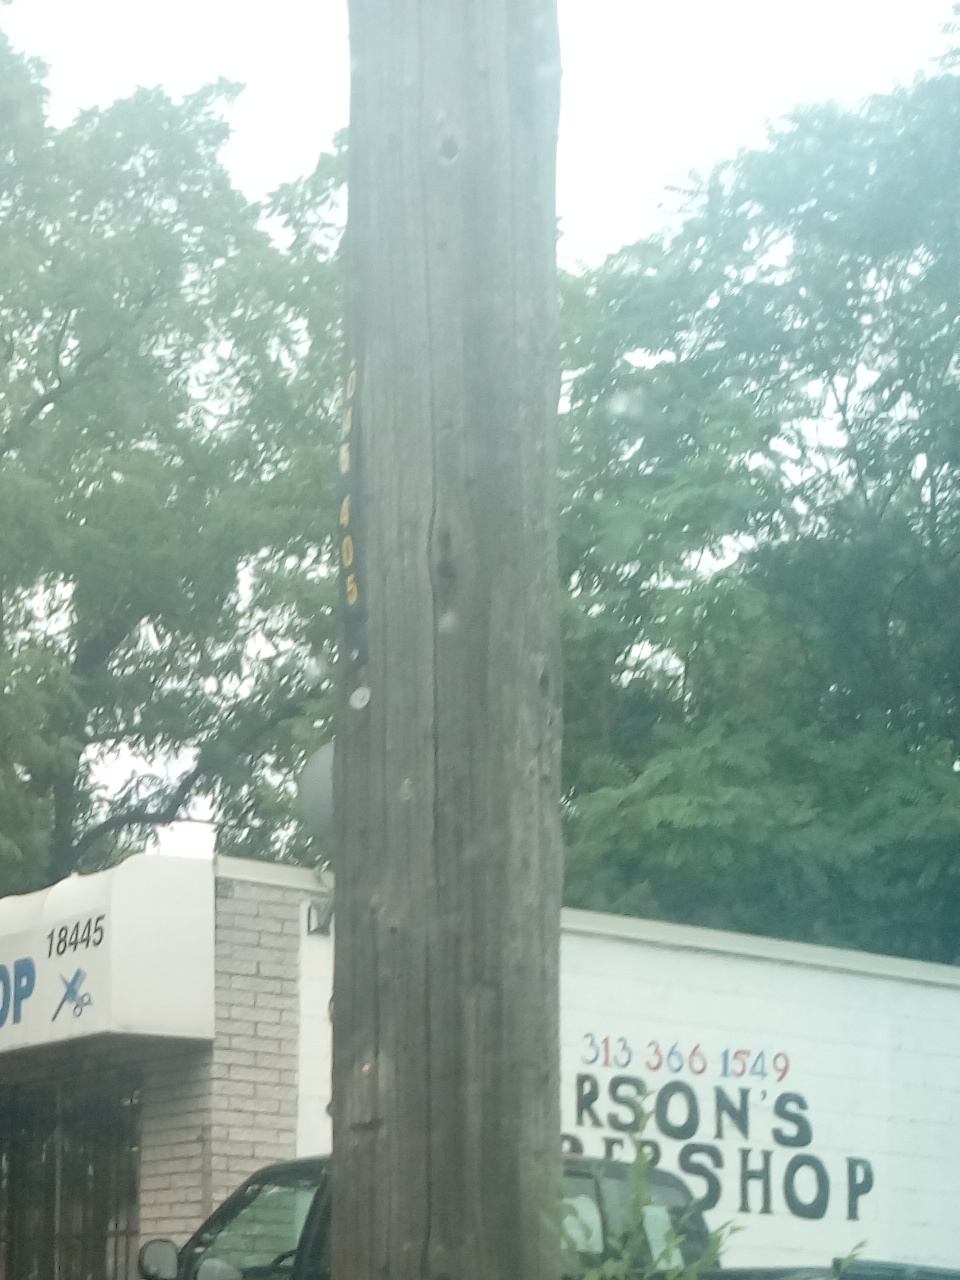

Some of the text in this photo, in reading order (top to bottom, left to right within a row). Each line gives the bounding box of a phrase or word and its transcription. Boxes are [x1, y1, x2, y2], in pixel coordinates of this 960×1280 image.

[45, 914, 107, 959] 18445
[581, 1032, 791, 1083] 313 366 1549
